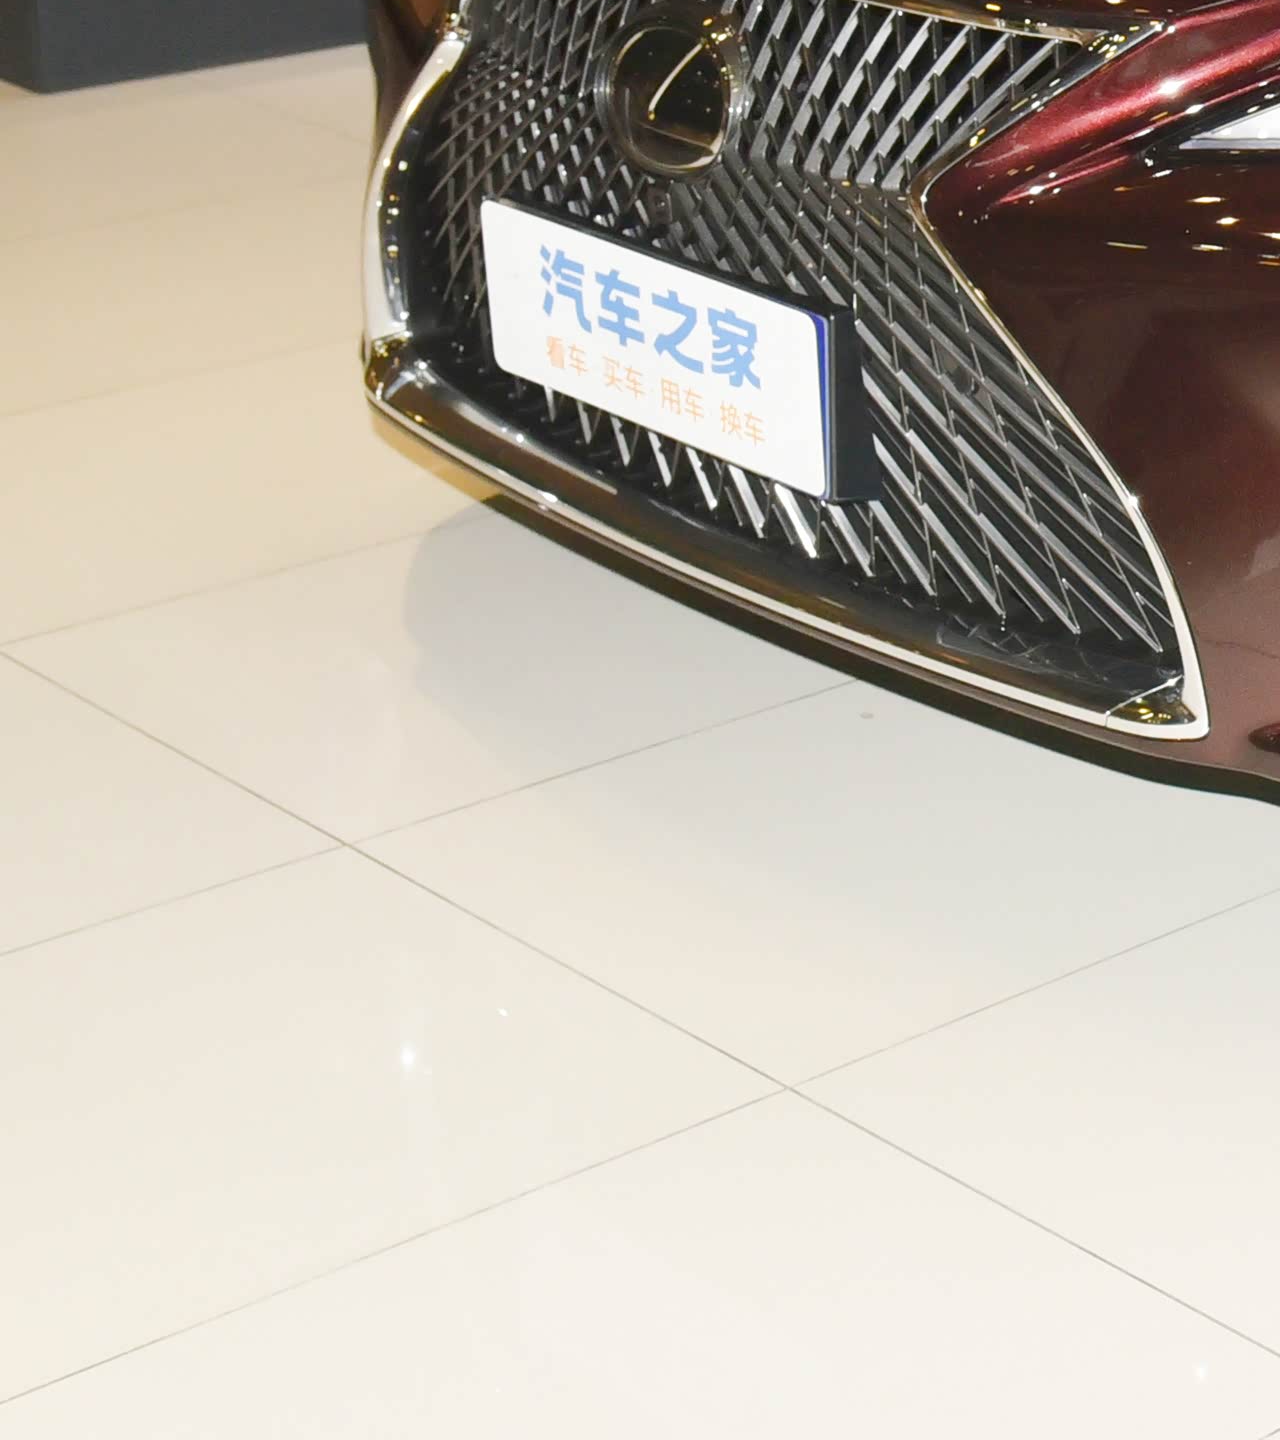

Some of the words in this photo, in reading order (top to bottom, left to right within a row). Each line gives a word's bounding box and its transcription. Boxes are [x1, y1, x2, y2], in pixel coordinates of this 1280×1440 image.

[539, 244, 762, 390] 汽车之家
[546, 335, 589, 377] 看车
[602, 355, 647, 401] 买车
[660, 376, 705, 424] 用车
[719, 400, 766, 448] 换车
